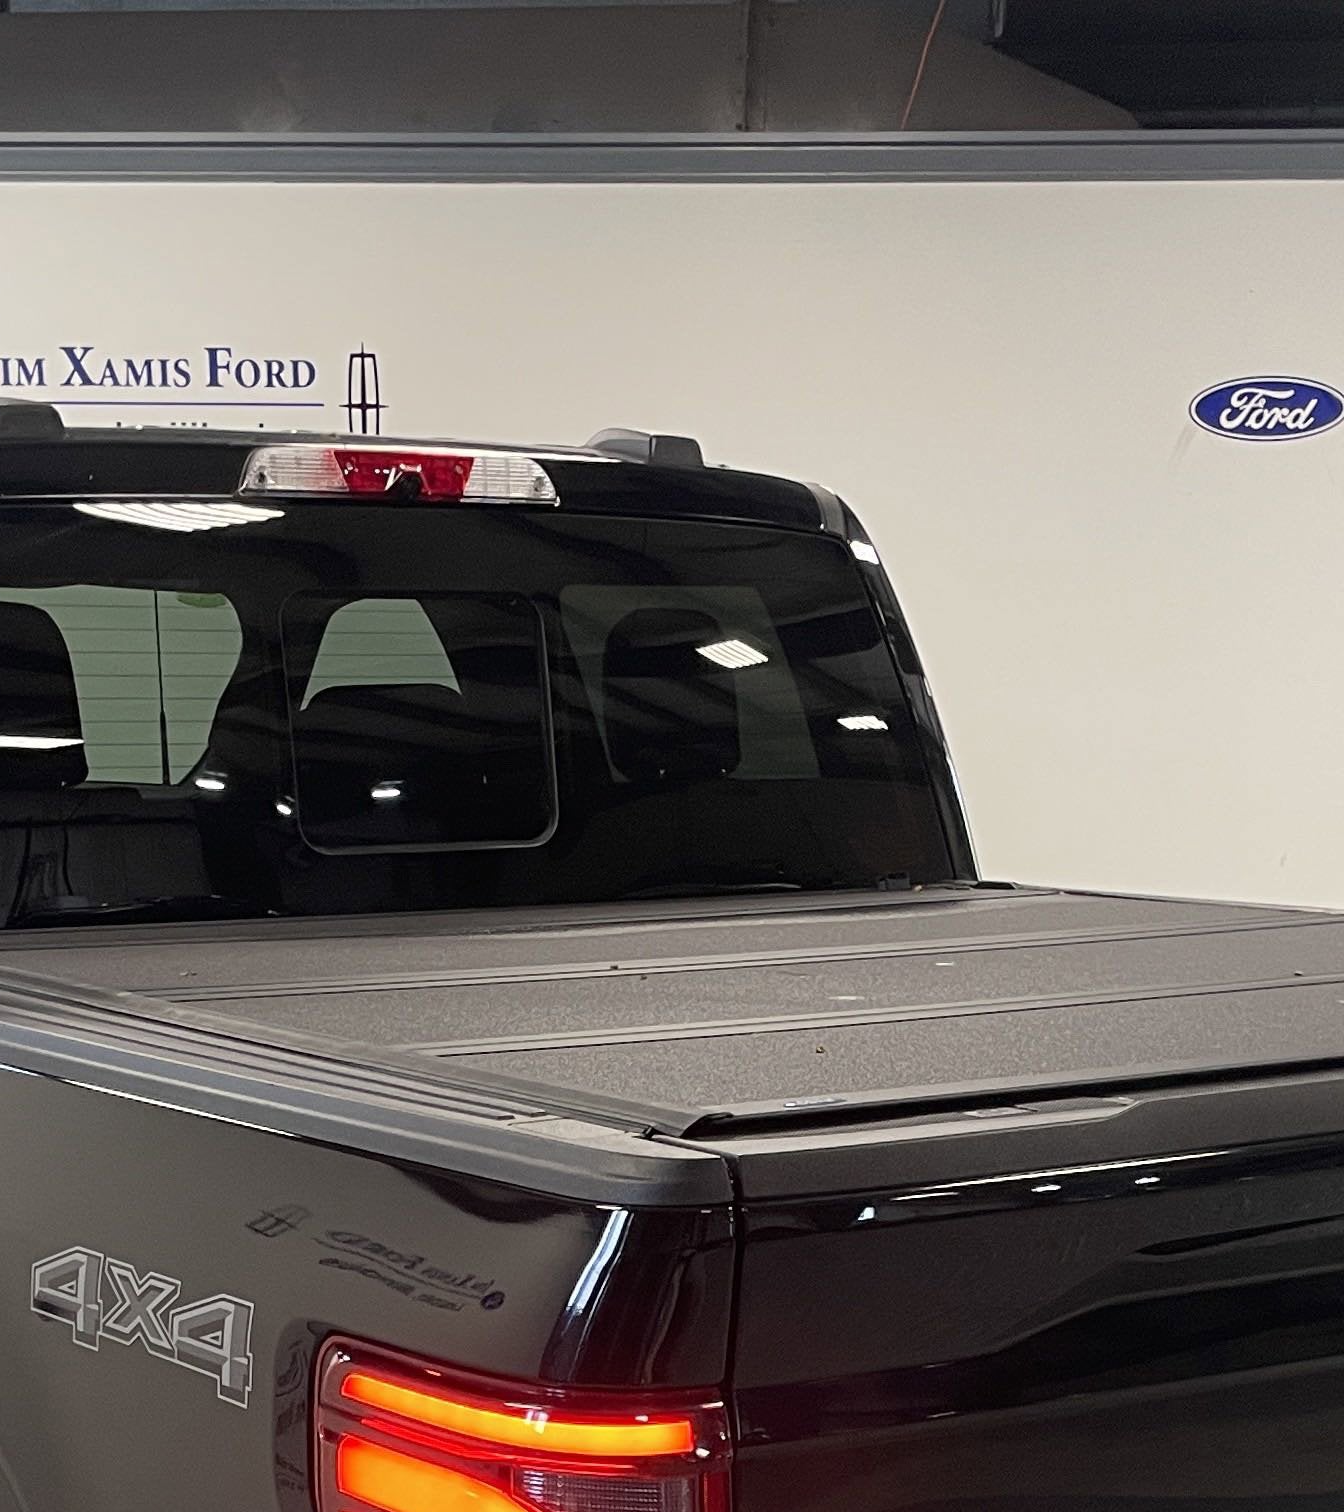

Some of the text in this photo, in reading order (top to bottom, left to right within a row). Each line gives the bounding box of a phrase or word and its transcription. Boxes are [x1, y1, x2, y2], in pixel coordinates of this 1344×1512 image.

[60, 346, 191, 388] XAMIS
[205, 346, 316, 389] FORD
[1219, 386, 1316, 433] Ford
